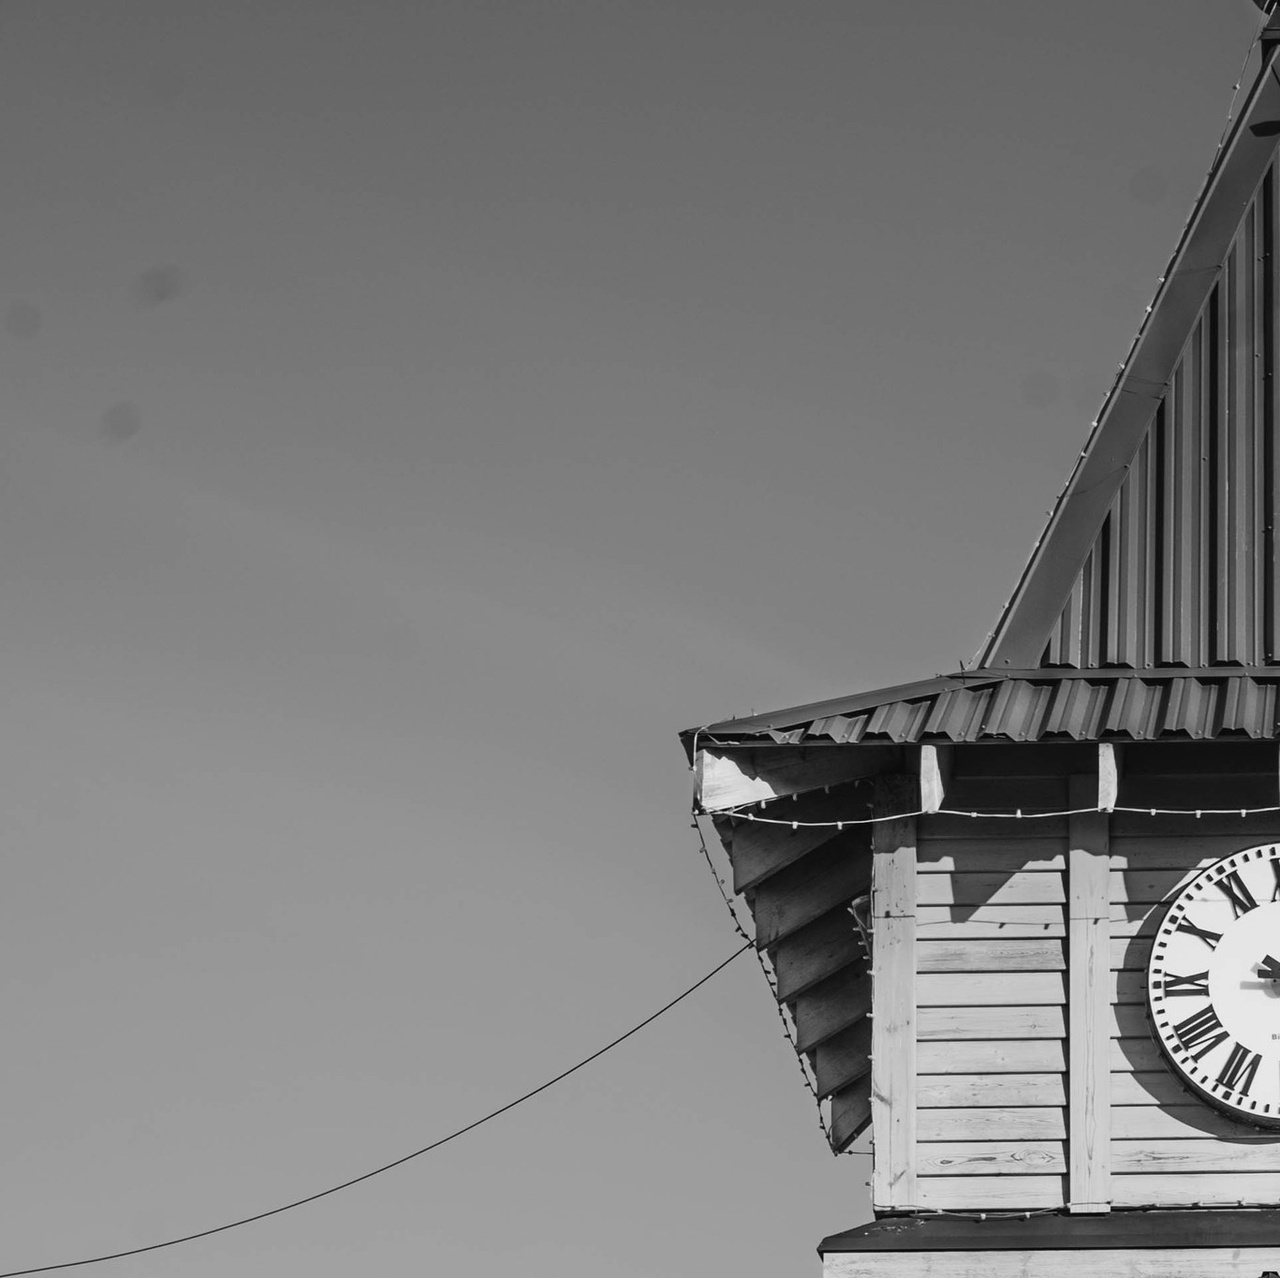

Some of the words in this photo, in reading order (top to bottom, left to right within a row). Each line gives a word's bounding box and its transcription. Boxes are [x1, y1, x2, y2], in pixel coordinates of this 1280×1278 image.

[1214, 869, 1259, 920] XI
[1175, 916, 1223, 951] X
[1164, 971, 1210, 998] IX
[1216, 1041, 1263, 1097] VII
